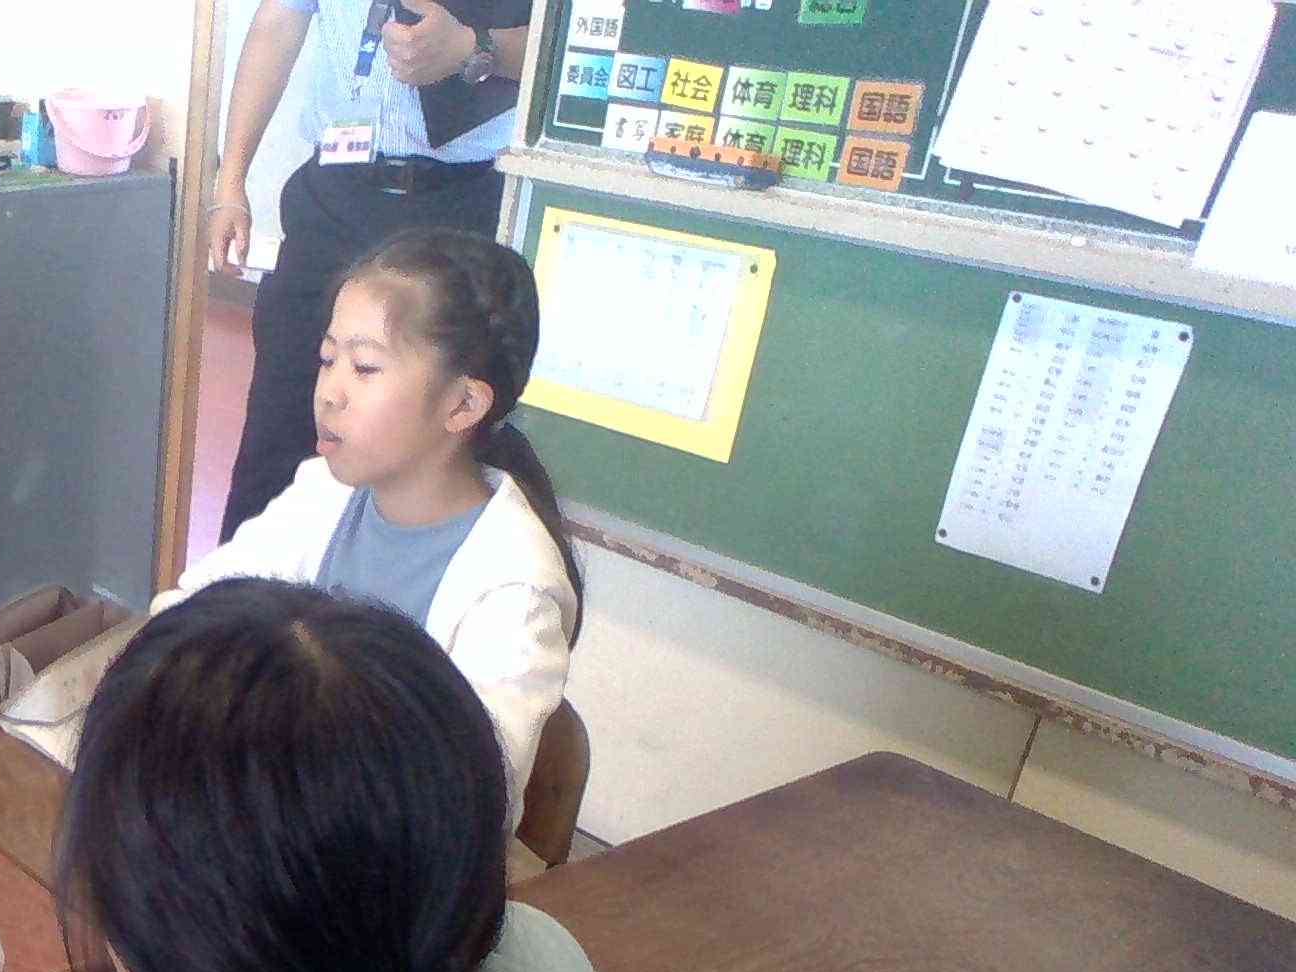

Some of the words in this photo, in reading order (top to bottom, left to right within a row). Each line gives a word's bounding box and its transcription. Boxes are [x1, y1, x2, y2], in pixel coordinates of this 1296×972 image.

[576, 16, 619, 38] 外国語
[567, 64, 609, 89] 委員会
[616, 62, 658, 92] 図工
[671, 69, 713, 102] 社会
[732, 76, 777, 110] 体育
[788, 82, 839, 115] 理科
[856, 91, 912, 124] 国語
[781, 137, 827, 171] 理科
[846, 146, 899, 181] 国語
